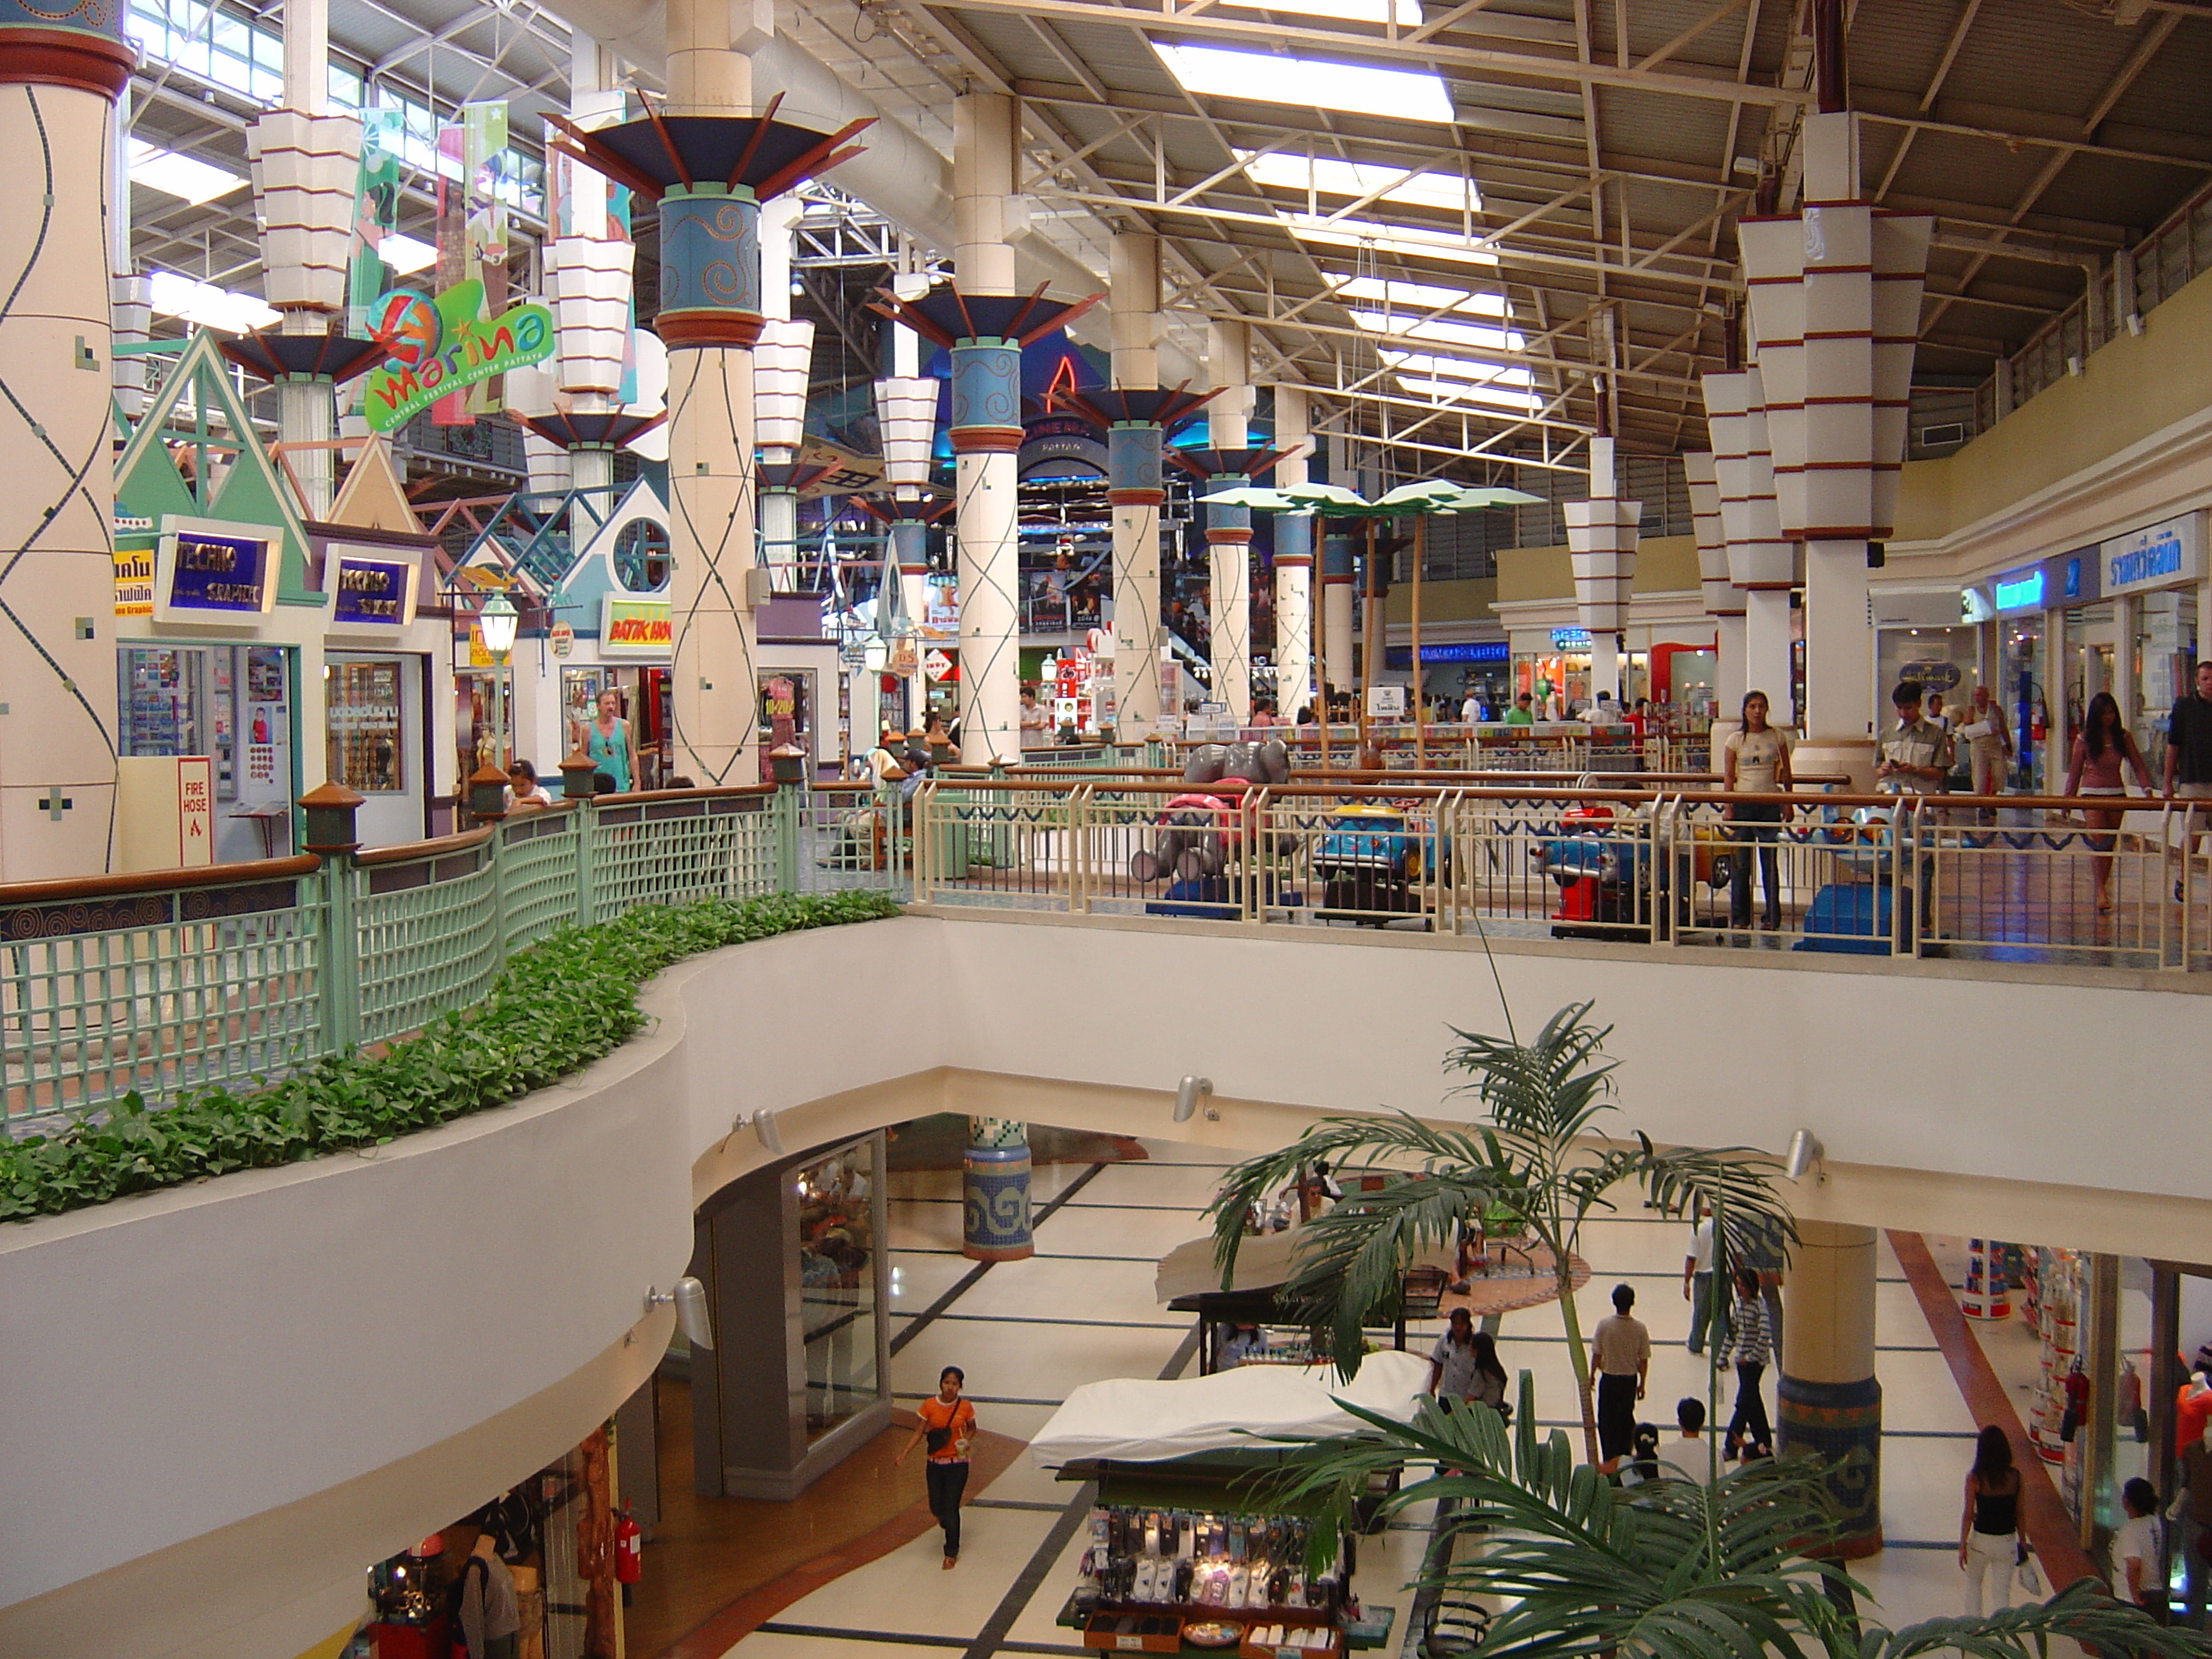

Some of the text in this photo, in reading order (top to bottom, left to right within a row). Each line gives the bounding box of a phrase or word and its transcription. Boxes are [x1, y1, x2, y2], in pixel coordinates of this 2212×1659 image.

[373, 312, 545, 410] Marina
[385, 352, 544, 428] CENTRAL FESTIVAL CENTER PATTAYA
[609, 619, 649, 641] BATIK
[185, 782, 204, 795] FIRE
[183, 798, 207, 812] HOSE
